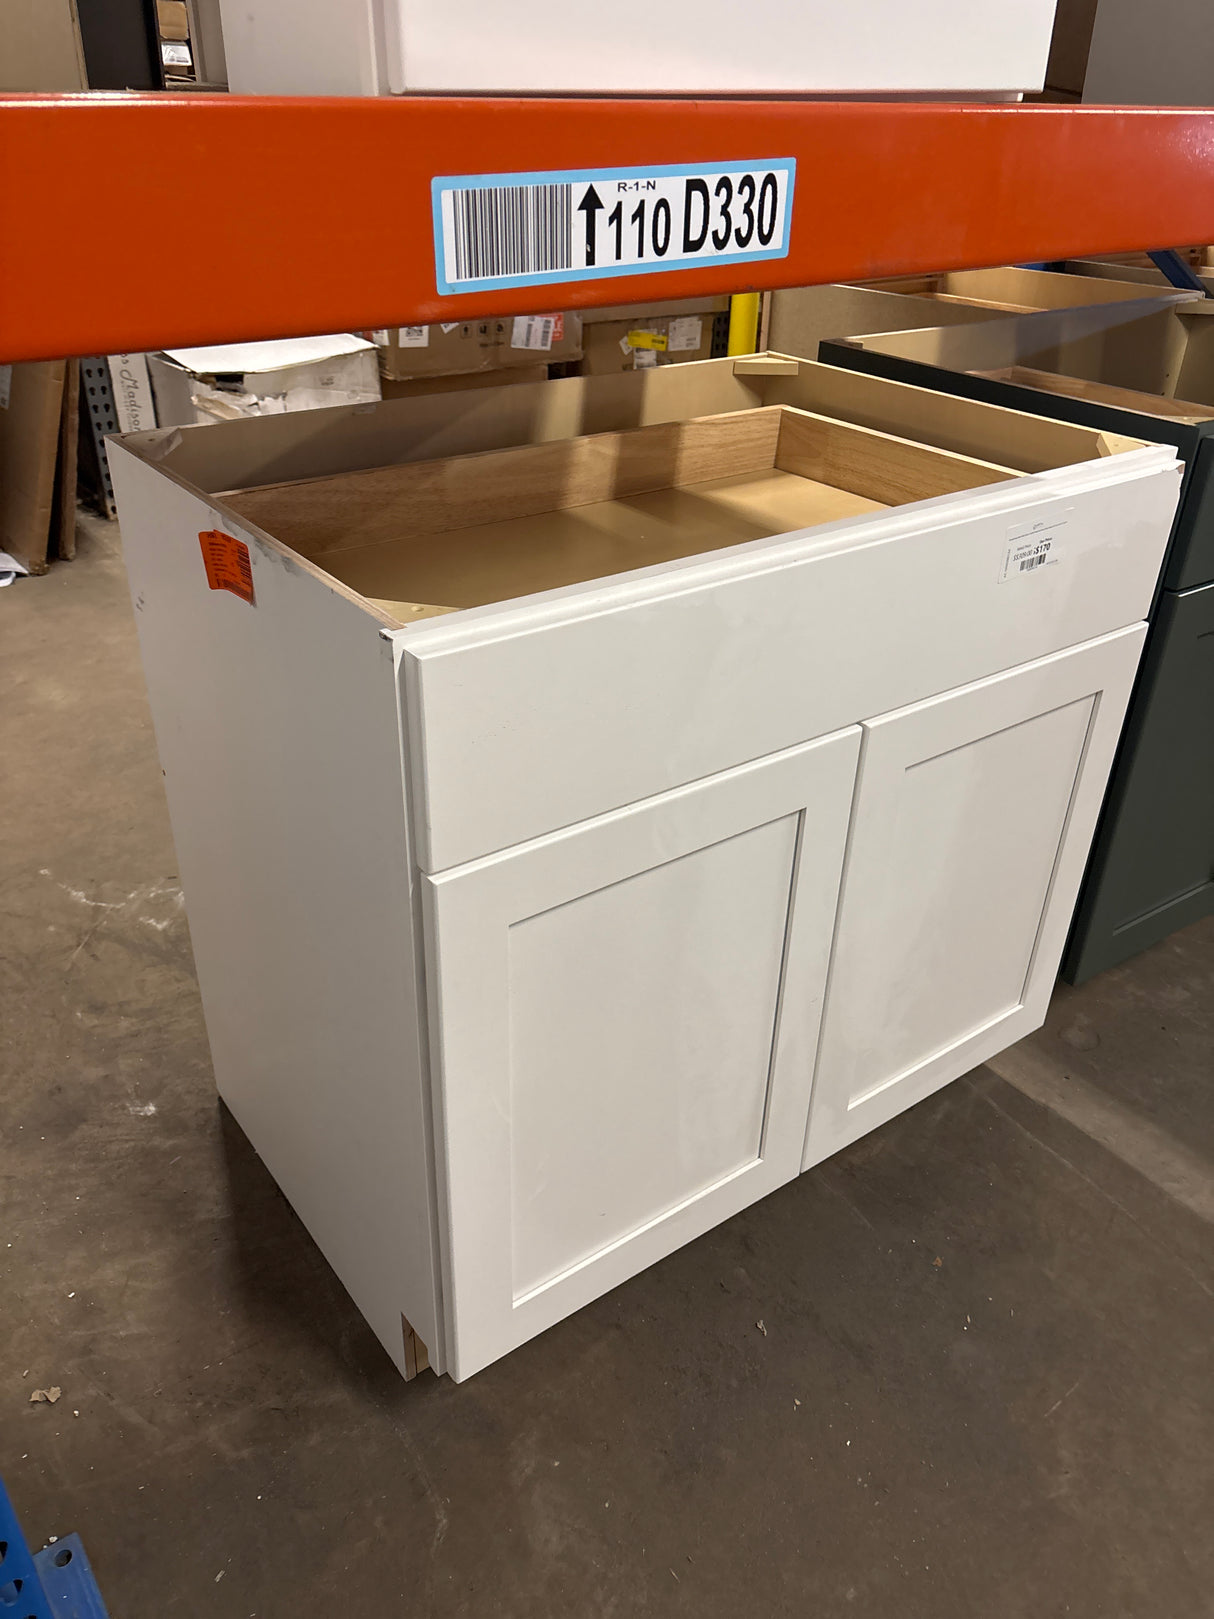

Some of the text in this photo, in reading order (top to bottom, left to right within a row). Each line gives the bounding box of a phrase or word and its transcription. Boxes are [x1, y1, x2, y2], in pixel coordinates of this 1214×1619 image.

[617, 180, 657, 193] R-1-N
[608, 172, 778, 260] 110 D330
